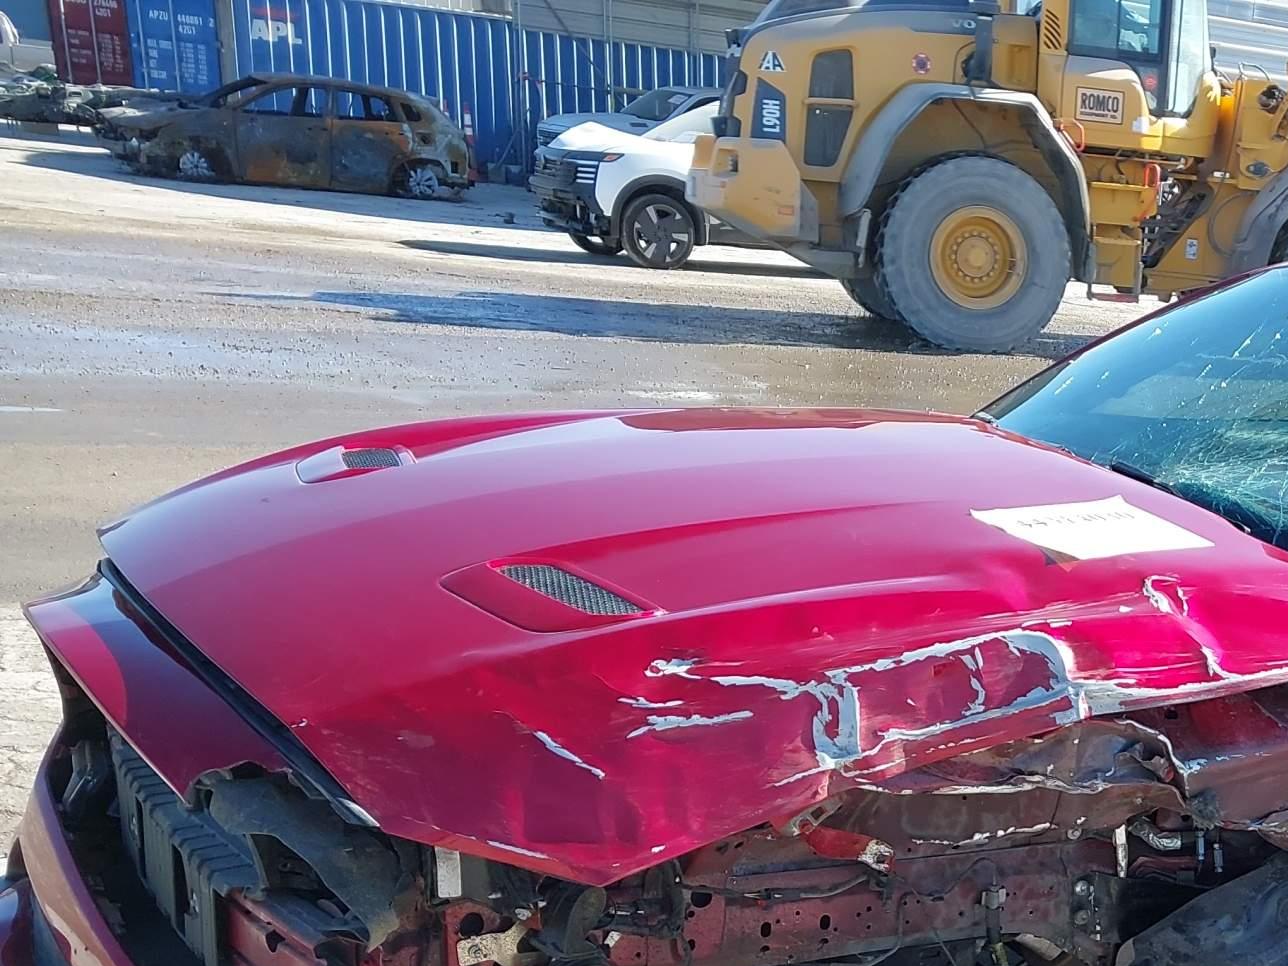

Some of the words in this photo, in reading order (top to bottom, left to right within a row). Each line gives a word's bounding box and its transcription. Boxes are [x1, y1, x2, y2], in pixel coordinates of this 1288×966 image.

[148, 9, 169, 21] APZU
[252, 19, 303, 45] APL
[1080, 92, 1120, 114] ROMCO
[762, 99, 781, 133] L90H
